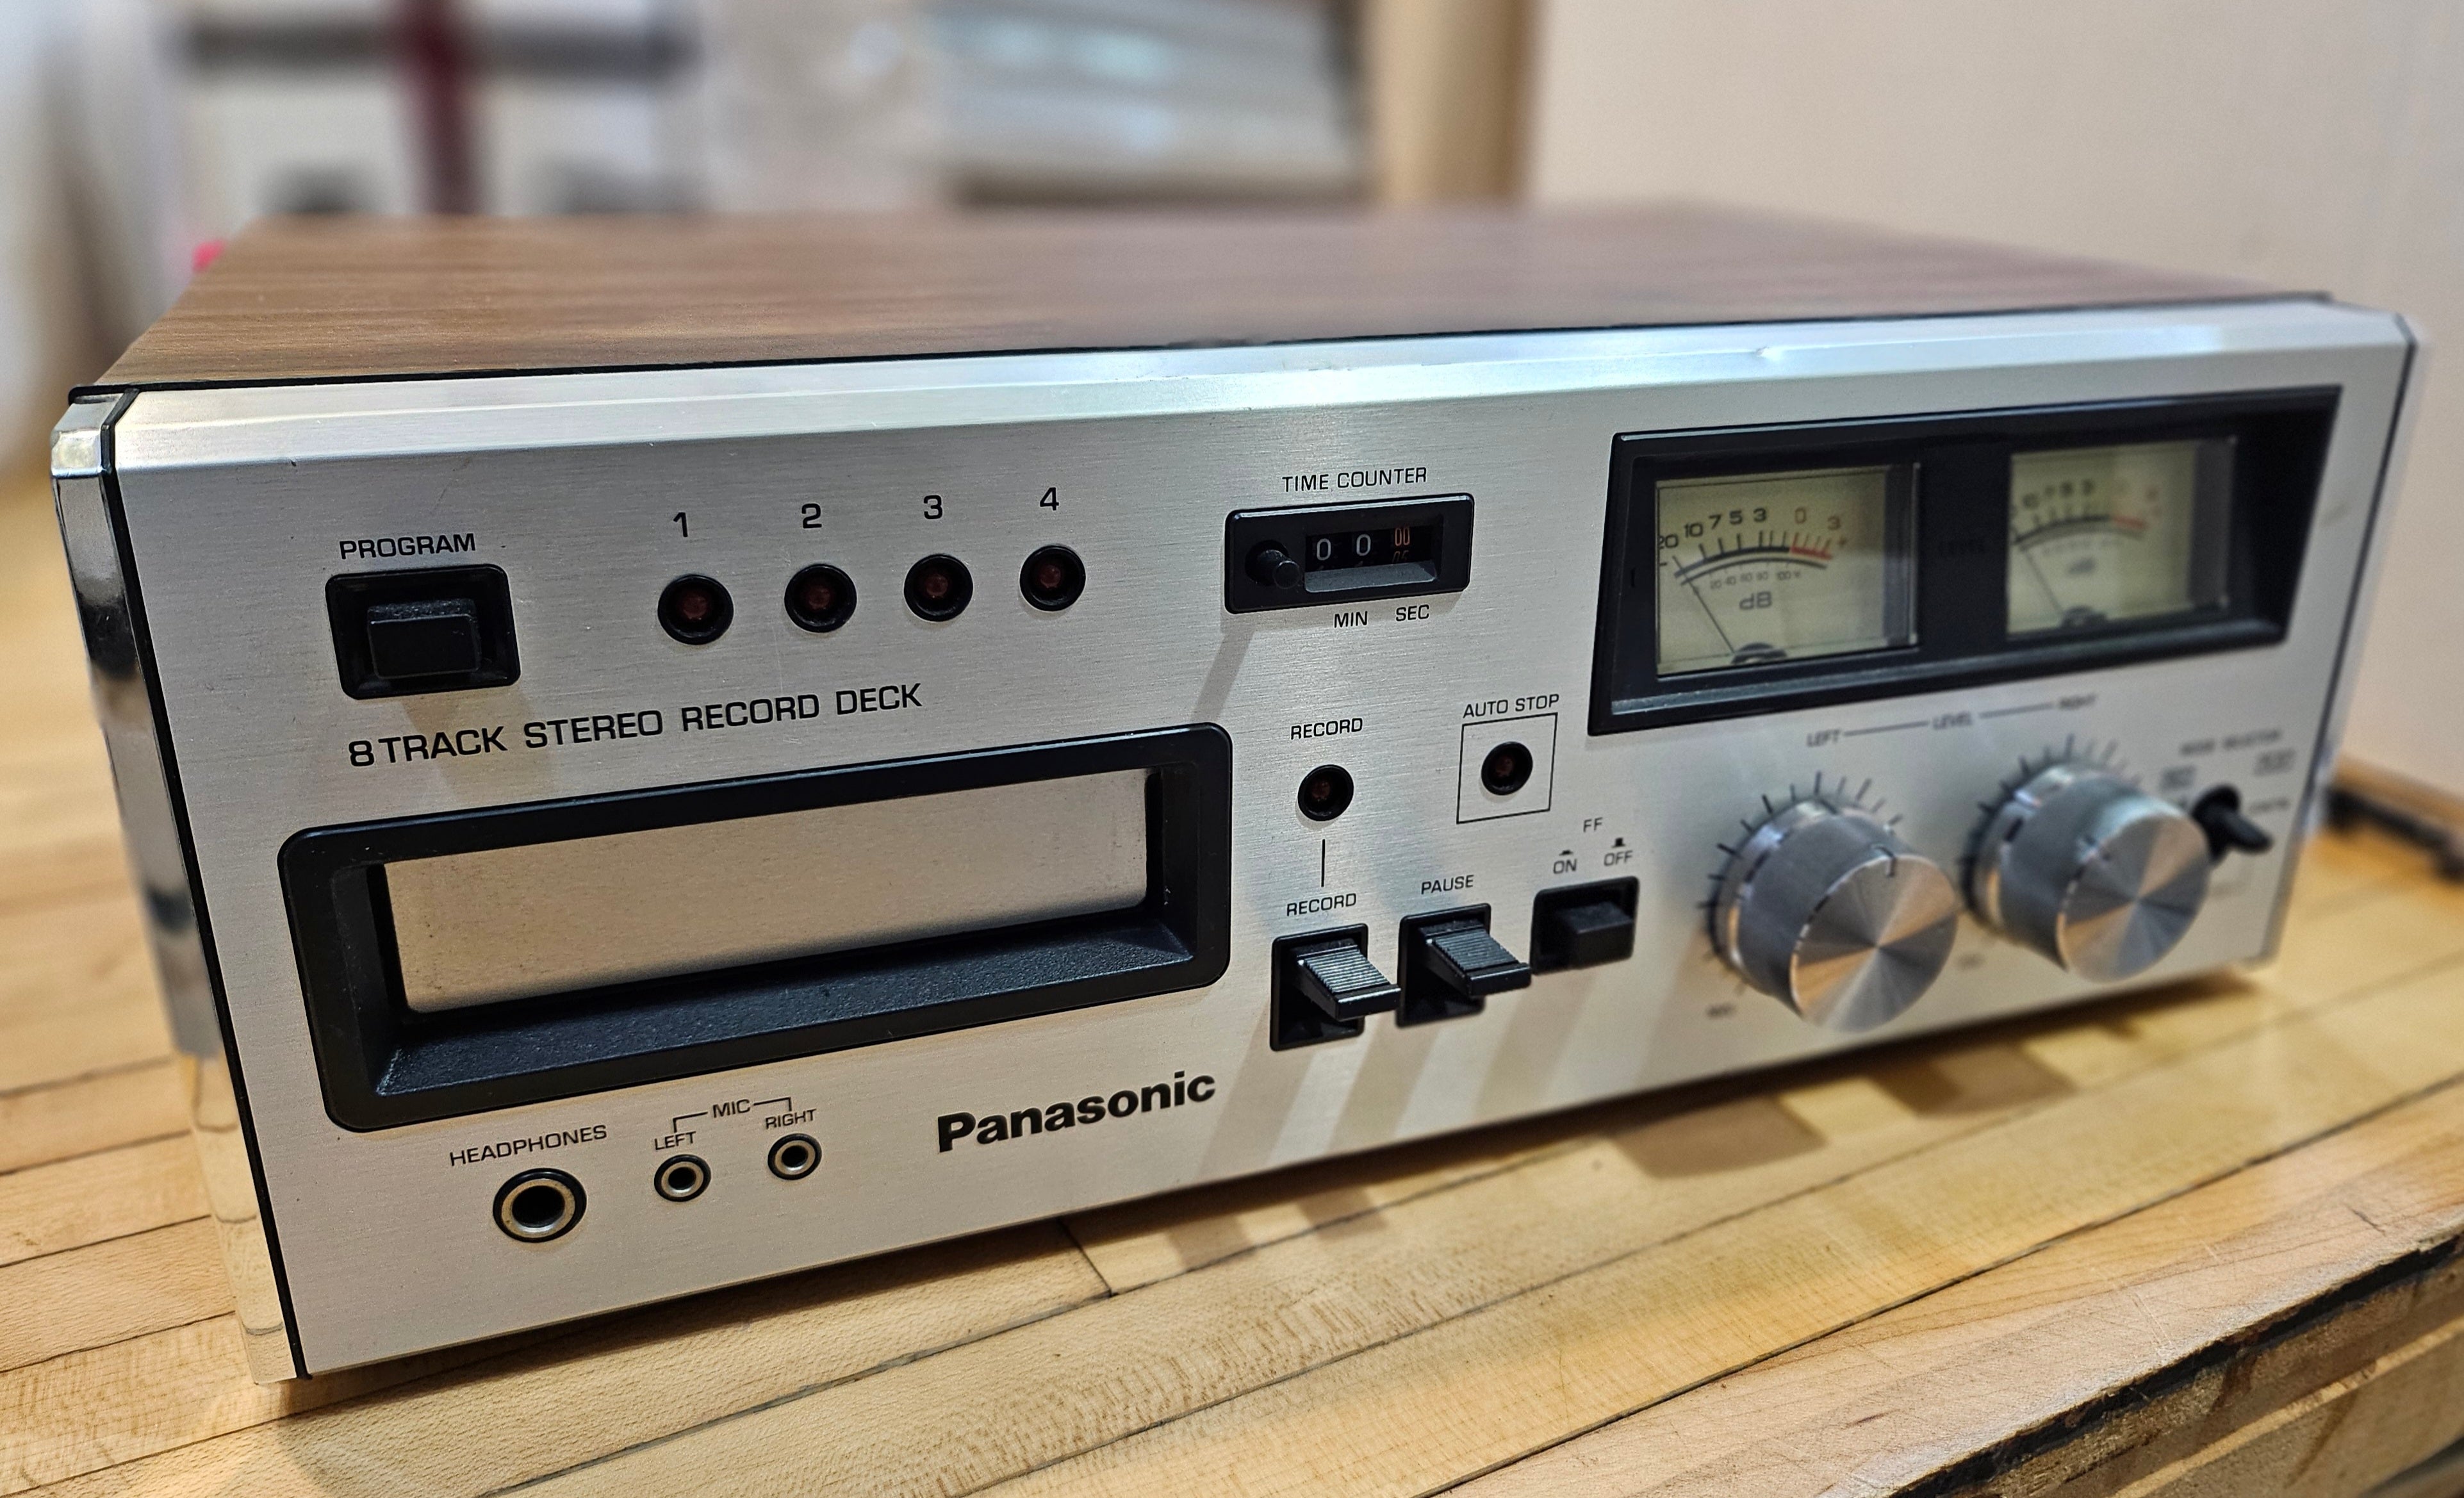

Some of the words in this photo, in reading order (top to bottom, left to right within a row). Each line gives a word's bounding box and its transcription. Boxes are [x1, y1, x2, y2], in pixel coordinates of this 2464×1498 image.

[1282, 474, 1329, 492] TIME
[1338, 467, 1426, 488] COUNTER
[673, 513, 687, 537] 1
[801, 504, 822, 529] 2
[924, 495, 942, 519] 3
[1040, 488, 1059, 511] 4
[1684, 523, 1703, 537] 10
[1709, 514, 1721, 529] 7
[1730, 510, 1743, 525] 5
[1754, 508, 1766, 522] 3
[1828, 516, 1841, 530] 3
[340, 533, 475, 559] PROGRAM
[1317, 539, 1331, 560] 0
[1356, 534, 1370, 556] 0
[1739, 591, 1772, 610] dB
[1335, 611, 1368, 628] MIN
[1396, 604, 1429, 621] SEC
[524, 711, 662, 748] STEREO
[682, 695, 819, 732] RECORD
[836, 683, 922, 714] DECK
[1463, 700, 1508, 718] AUTO
[1515, 694, 1559, 711] STOP
[1291, 718, 1363, 739] RECORD
[1584, 818, 1602, 832] FF
[1553, 859, 1577, 874] ON
[1604, 850, 1632, 866] OFF
[1422, 875, 1474, 894] PAUSE
[1287, 893, 1356, 916] RECORD
[713, 1099, 750, 1118] MIC
[938, 1071, 1215, 1153] Panasonic
[655, 1131, 696, 1150] LEFT
[766, 1108, 816, 1129] RIGHT
[450, 1125, 607, 1167] HEADPHONES
